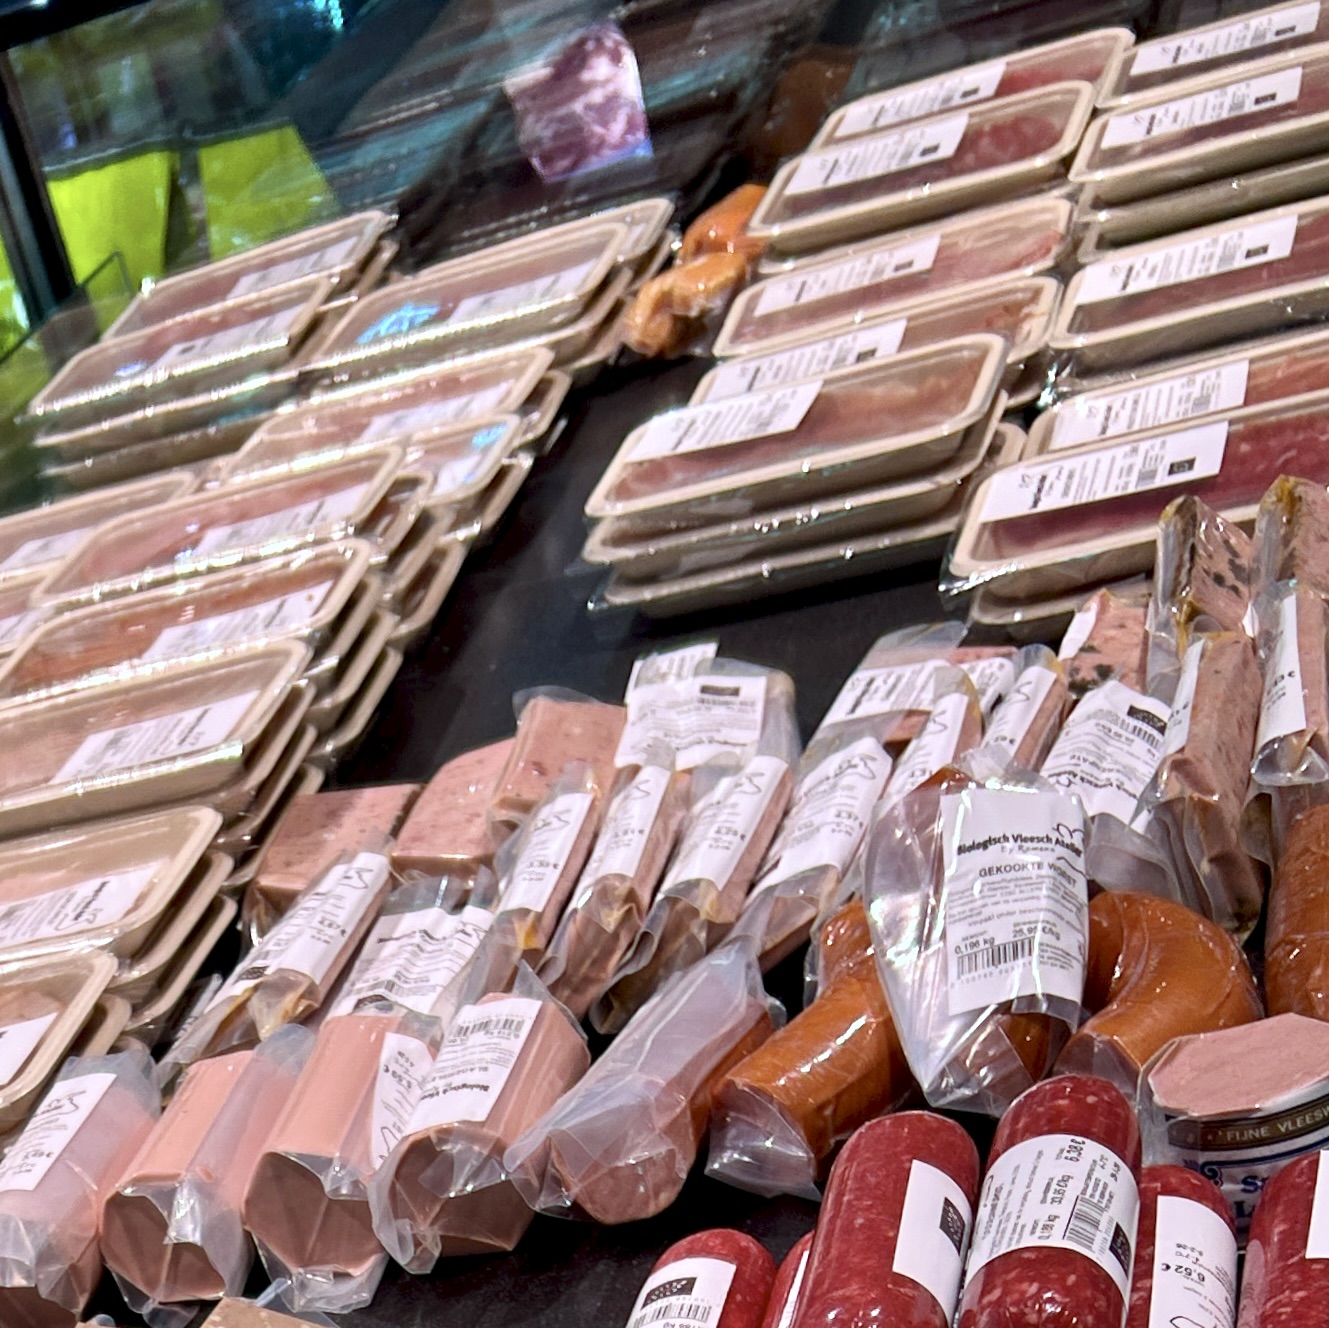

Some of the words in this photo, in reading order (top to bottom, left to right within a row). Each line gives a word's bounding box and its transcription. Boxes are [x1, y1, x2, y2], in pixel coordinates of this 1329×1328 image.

[956, 833, 1009, 855] Biologisch
[1011, 833, 1052, 850] Vleesch
[978, 861, 1043, 878] GEKOOKTE
